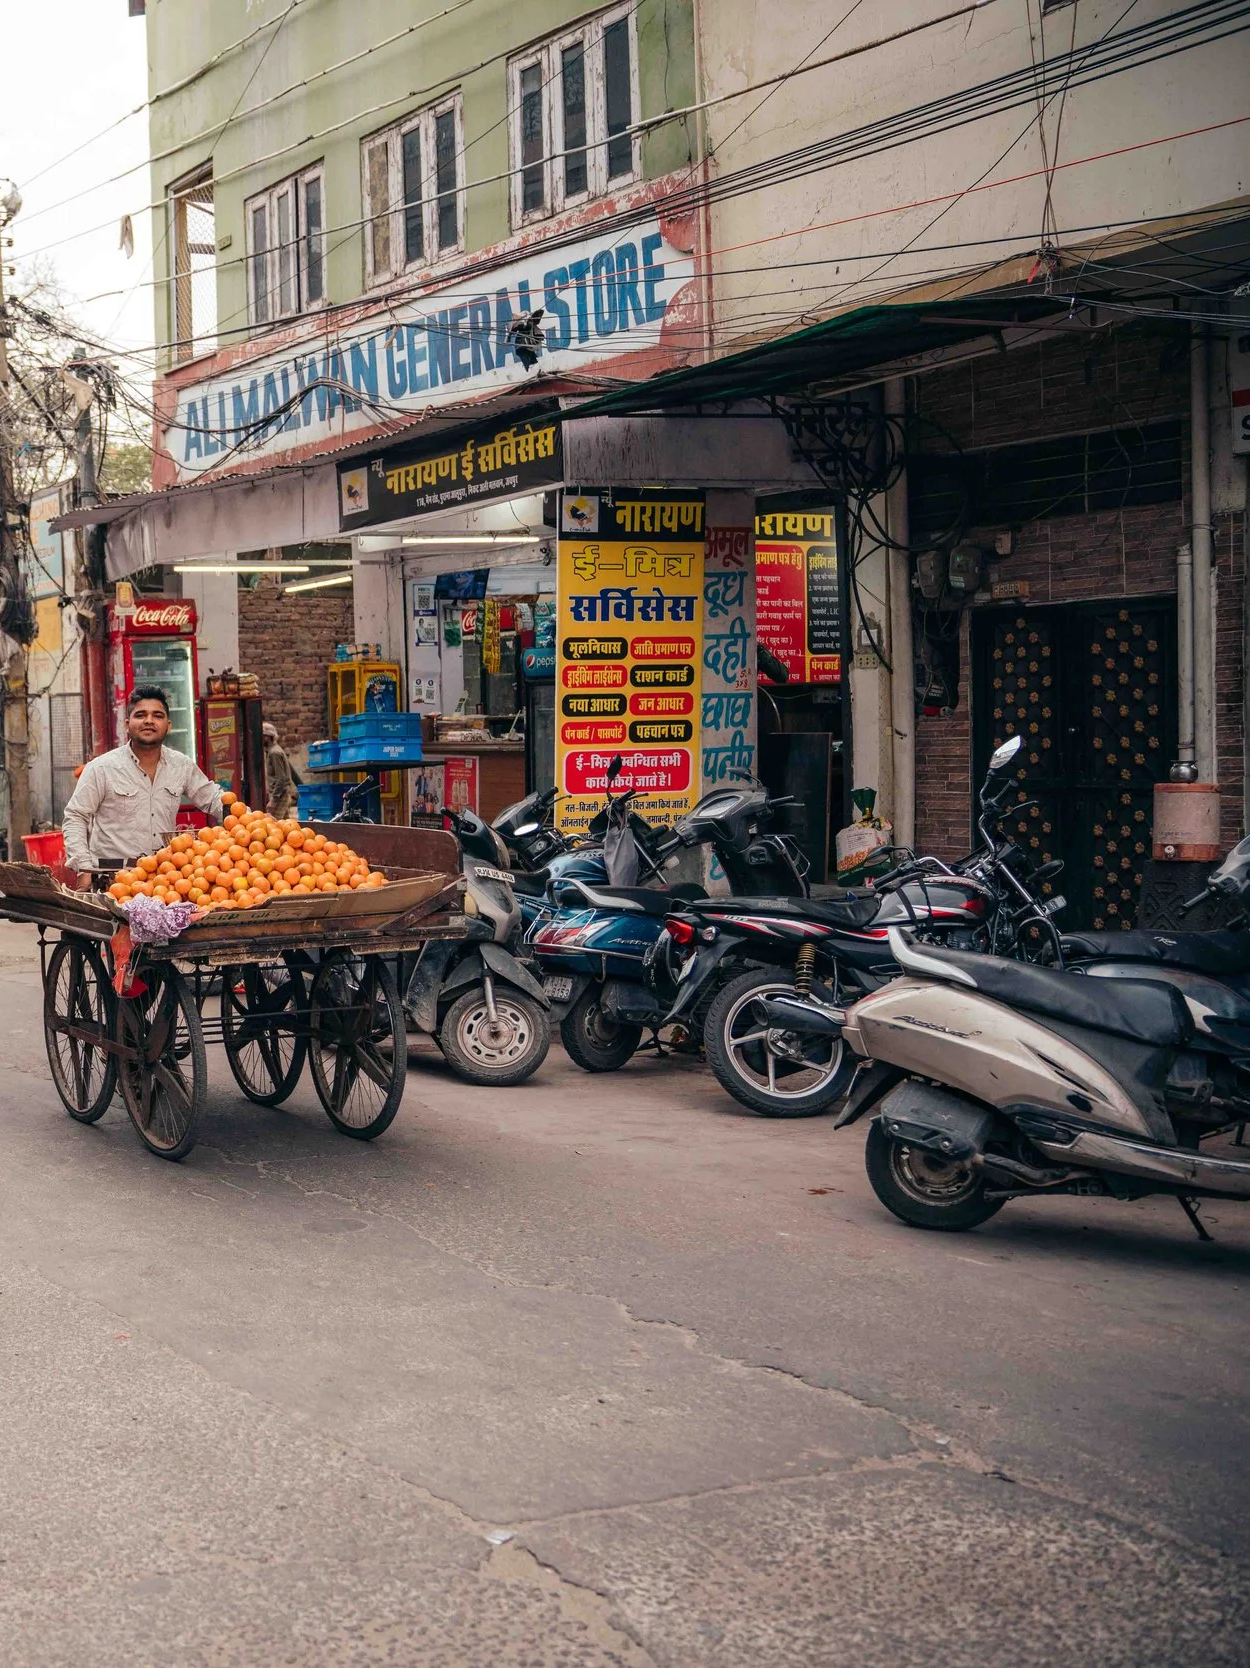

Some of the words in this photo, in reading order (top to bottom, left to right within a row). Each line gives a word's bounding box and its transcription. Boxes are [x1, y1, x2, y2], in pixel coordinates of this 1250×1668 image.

[185, 390, 227, 462] ALI
[385, 279, 543, 399] GENERAL
[543, 232, 668, 353] STORE
[386, 453, 459, 495] नारायण
[461, 439, 475, 482] ई
[477, 423, 556, 473] सर्विसेस
[615, 501, 704, 533] नारायण
[703, 570, 749, 618] दूध
[569, 587, 698, 622] सर्विसेस
[569, 639, 622, 659] मूलनिवास
[634, 640, 654, 655] जाति
[655, 643, 678, 656] प्रमाण
[680, 643, 692, 655] पत्र
[703, 616, 752, 684] दही
[536, 657, 555, 669] peps
[635, 670, 664, 683] राशन
[665, 666, 688, 682] कार्ड
[569, 698, 589, 712] नया
[590, 698, 620, 712] आधार
[638, 698, 655, 711] जन
[657, 697, 685, 711] आधार
[576, 726, 590, 739] कार्ड
[598, 725, 623, 739] पासपोर्ट
[636, 725, 669, 738] पहचान
[670, 724, 685, 738] पत्र
[620, 753, 658, 768] म्बन्धित
[660, 752, 681, 767] सभी
[635, 772, 657, 787] जाते
